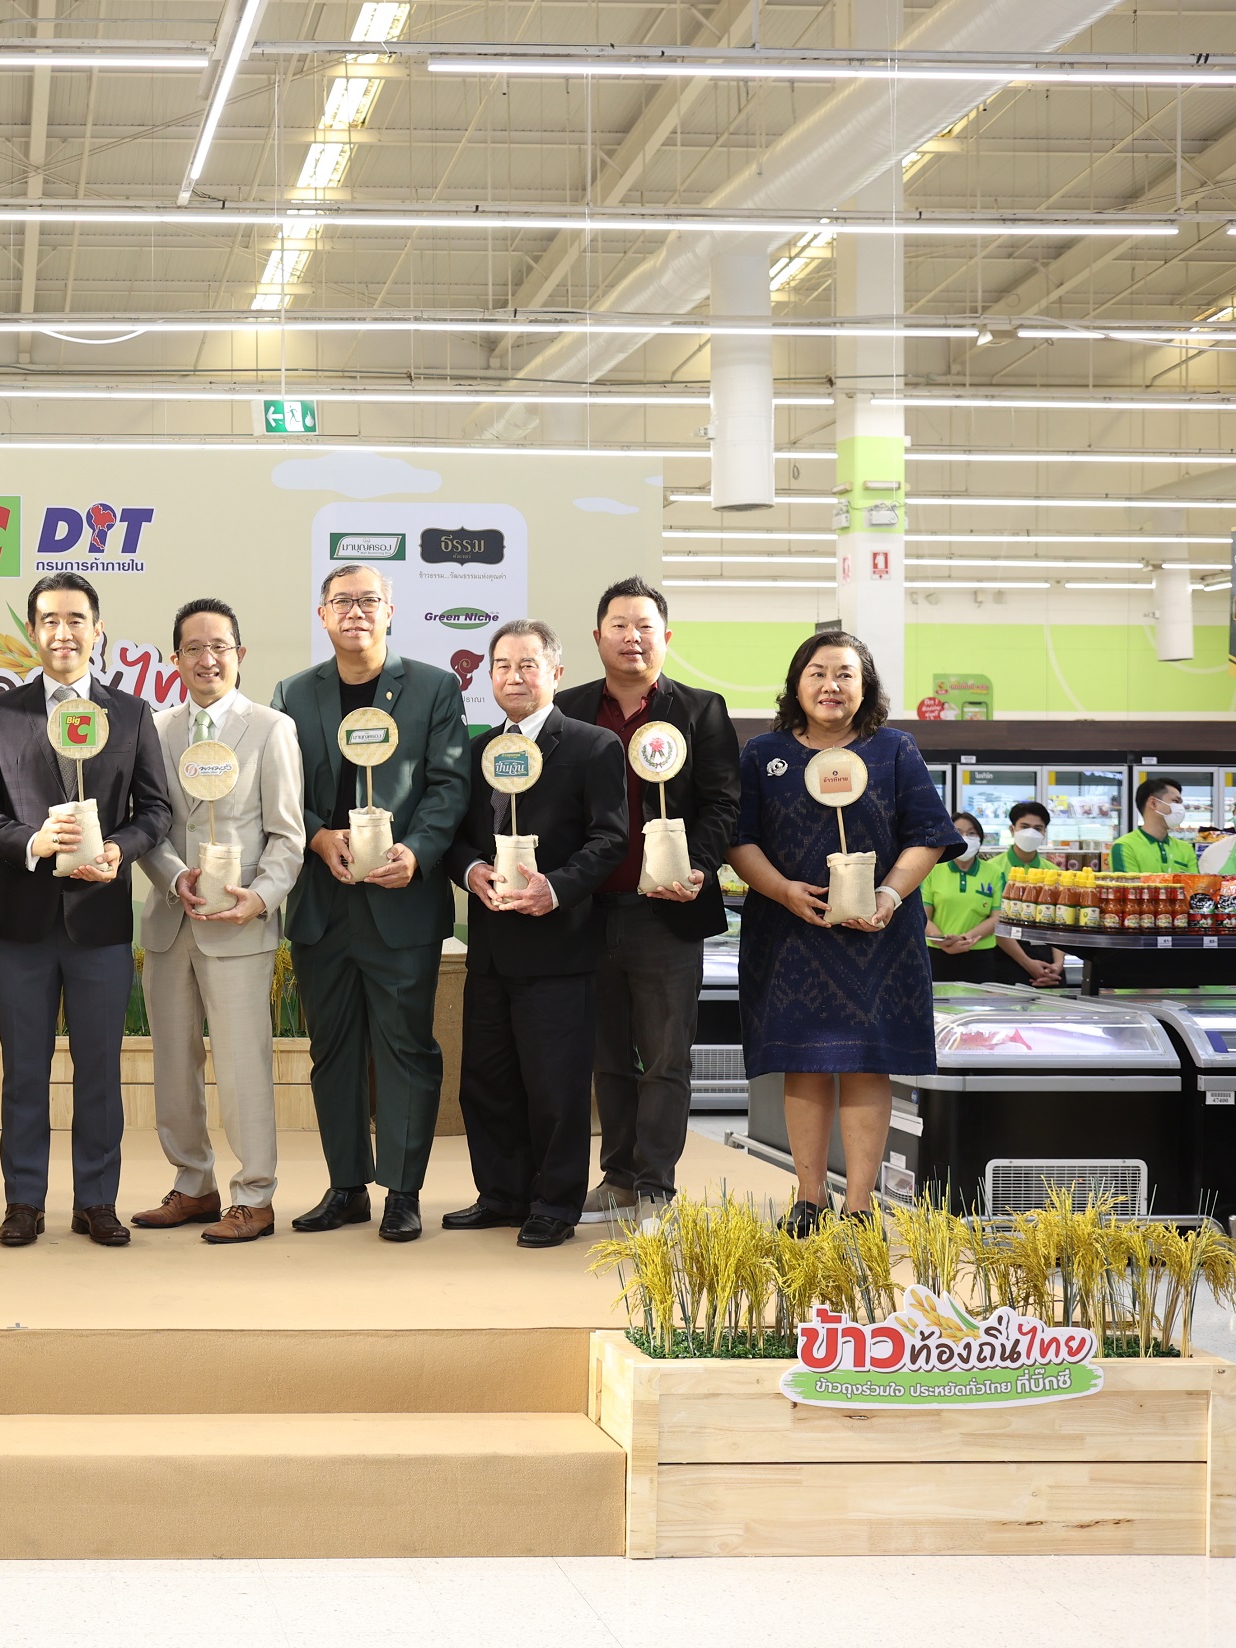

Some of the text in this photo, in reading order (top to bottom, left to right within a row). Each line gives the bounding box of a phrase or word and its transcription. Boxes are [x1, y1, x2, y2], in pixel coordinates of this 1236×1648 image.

[37, 503, 155, 553] DIT
[342, 544, 392, 553] มาบุญครอง
[441, 535, 484, 553] ธรรม
[36, 558, 144, 572] กรมการค้าภายใน
[425, 612, 499, 622] Green Niche
[66, 715, 80, 725] Big
[67, 716, 91, 744] C
[800, 1308, 1086, 1368] ข้าวท้องถิ่นไทย
[815, 1368, 1071, 1398] ข้าวถุงร่วมใจ ประหยัดทั่วไทย ที่บิ๊กซี
